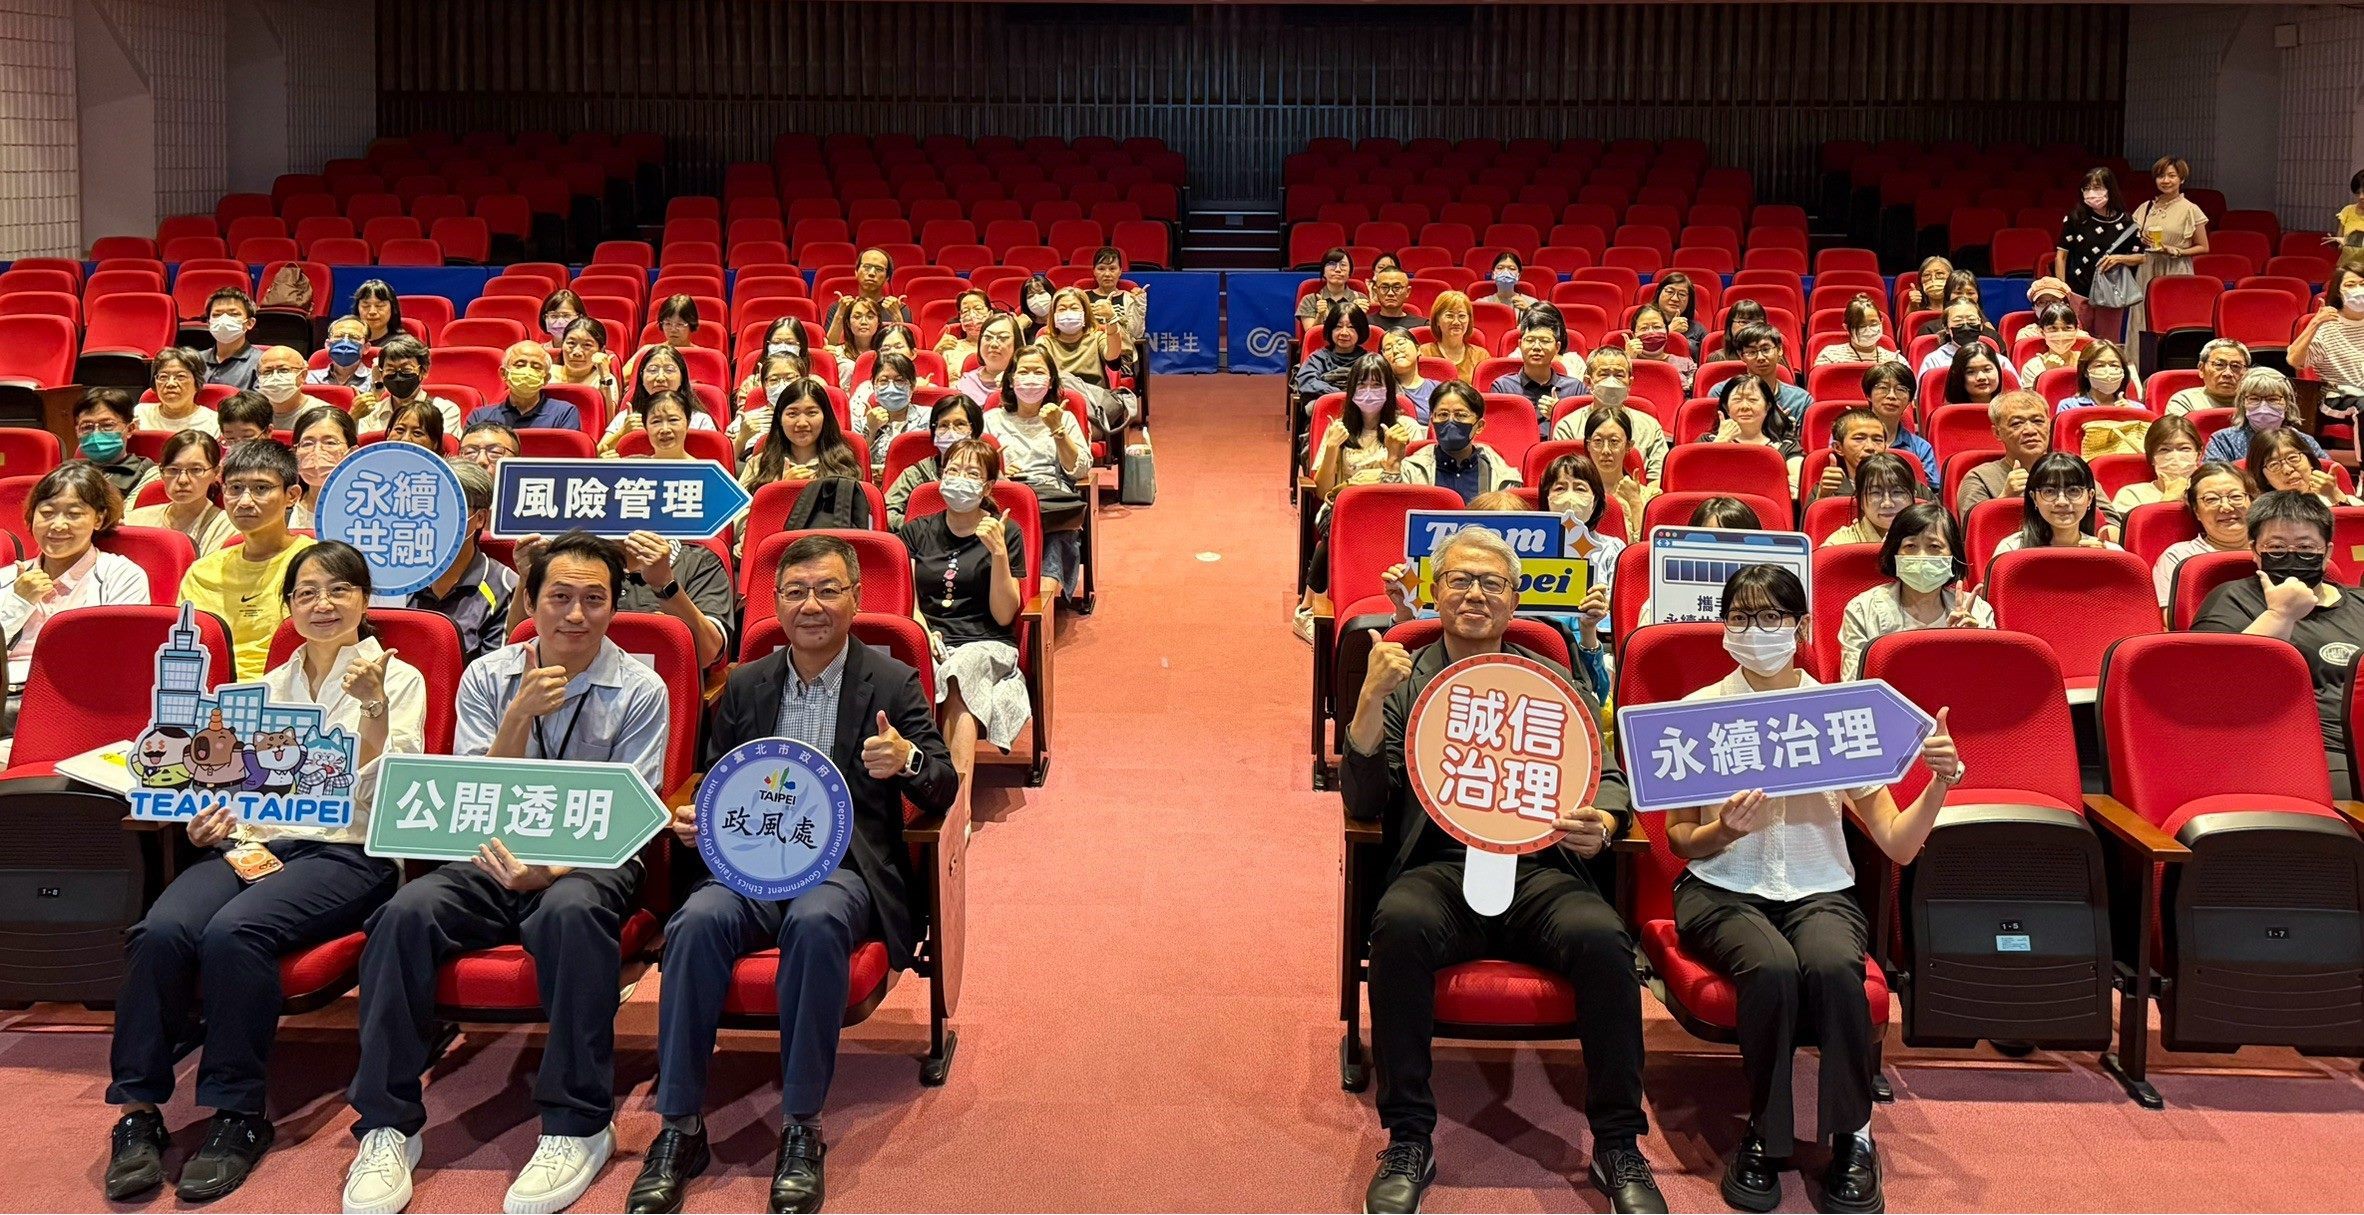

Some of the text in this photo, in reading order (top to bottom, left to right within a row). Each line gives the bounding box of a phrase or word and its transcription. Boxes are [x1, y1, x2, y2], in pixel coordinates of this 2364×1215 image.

[347, 471, 440, 518] 永續
[512, 477, 705, 519] 風險管理
[347, 520, 437, 567] 共融
[1426, 522, 1547, 553] Tm
[1448, 686, 1565, 757] 誠信
[732, 743, 831, 778] 臺北市政府
[1652, 707, 1883, 781] 永續治理
[759, 790, 796, 805] TAIPEI
[1438, 746, 1559, 820] 治理
[238, 797, 350, 824] TAIPEI
[396, 779, 613, 841] 公開透明
[700, 779, 719, 836] Government
[722, 805, 818, 850] 政風處
[831, 800, 846, 856] Department
[704, 837, 716, 856] City
[821, 859, 832, 873] of
[711, 855, 732, 881] Taipei
[767, 869, 822, 895] Government
[2267, 930, 2285, 938] 1-7
